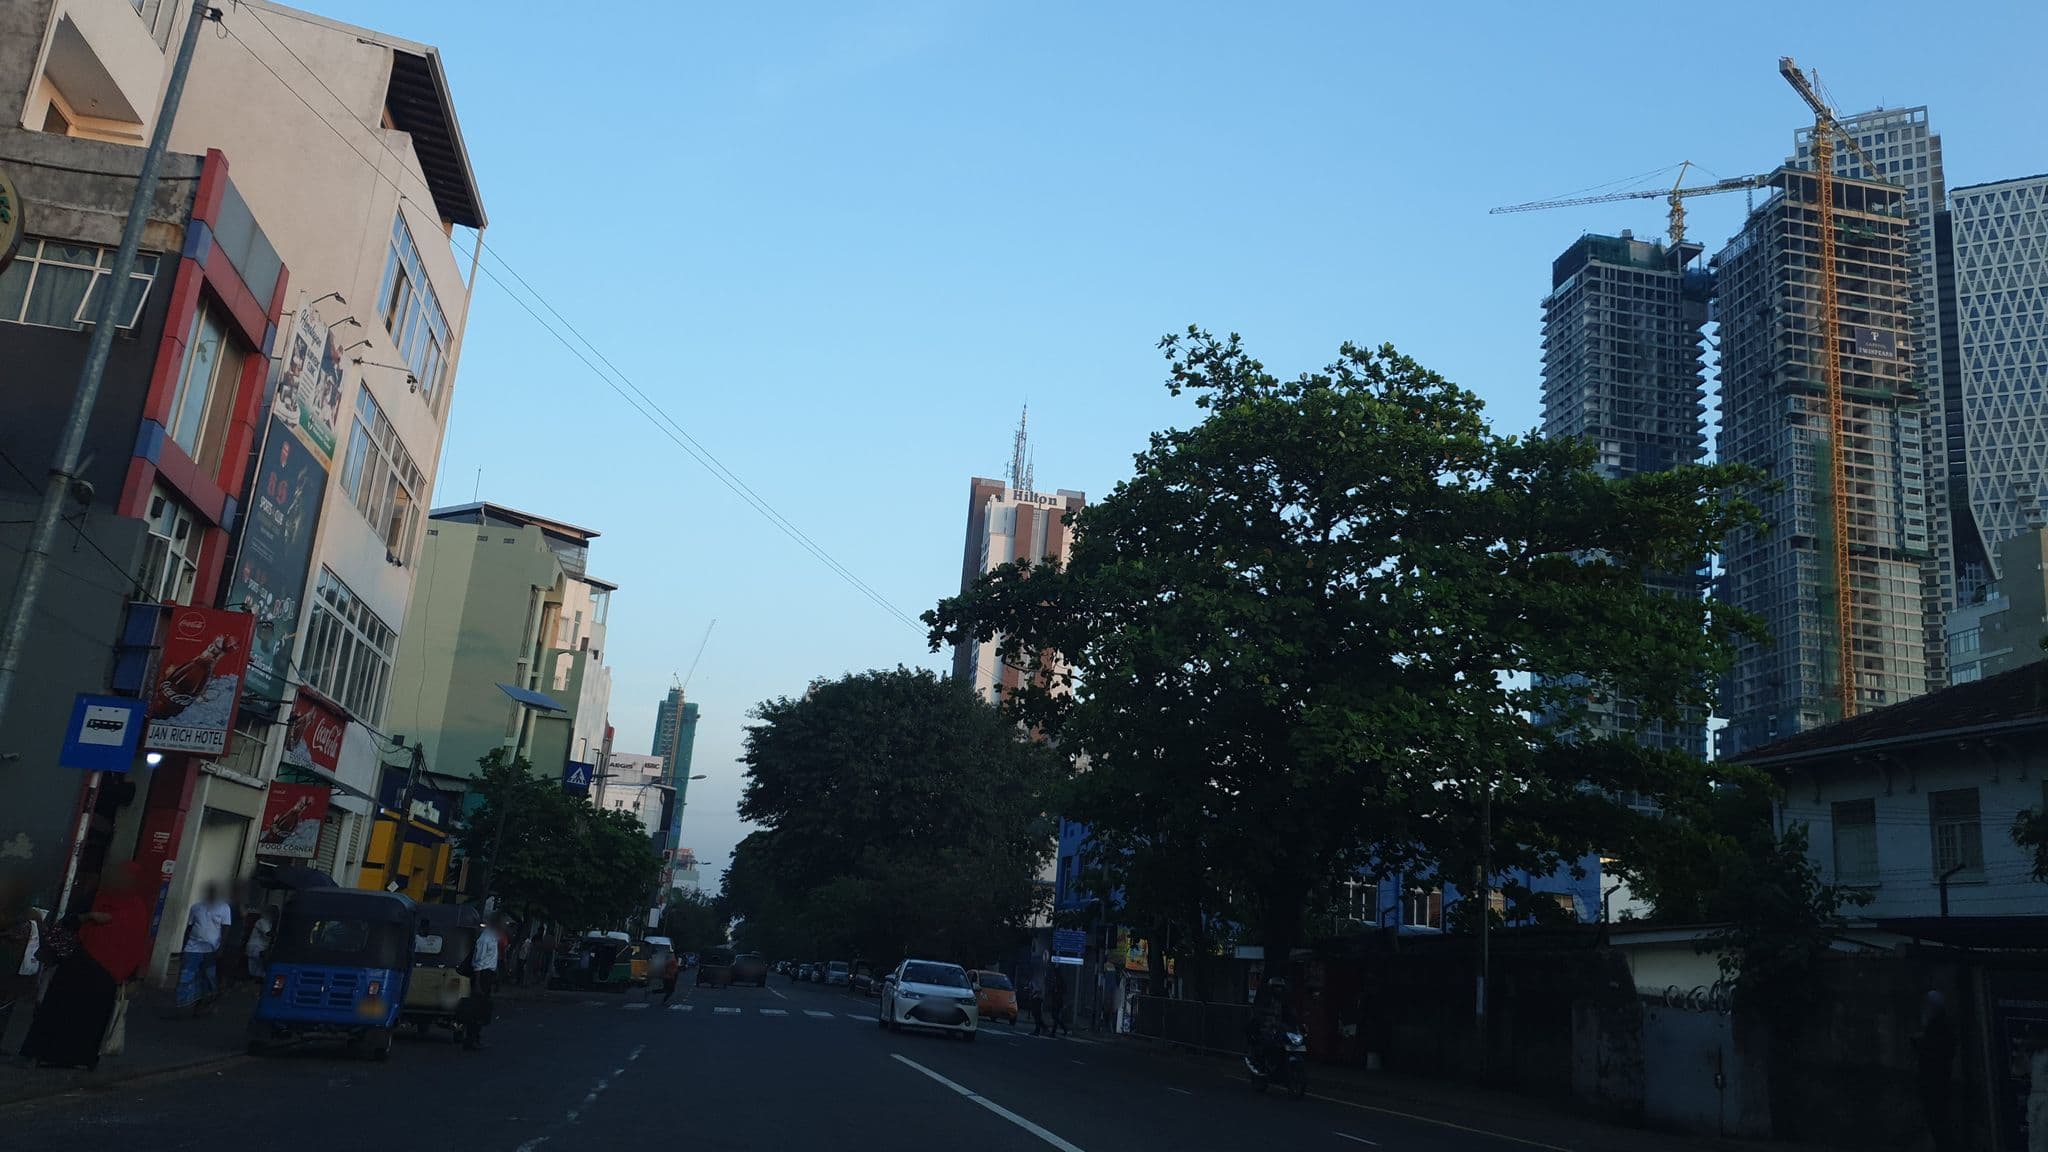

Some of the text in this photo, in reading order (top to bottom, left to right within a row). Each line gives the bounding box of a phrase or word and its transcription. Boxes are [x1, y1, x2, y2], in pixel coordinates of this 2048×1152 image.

[1014, 490, 1057, 504] Hilton
[148, 726, 168, 740] JAN
[170, 728, 193, 743] RICH
[194, 730, 223, 746] HOTEL
